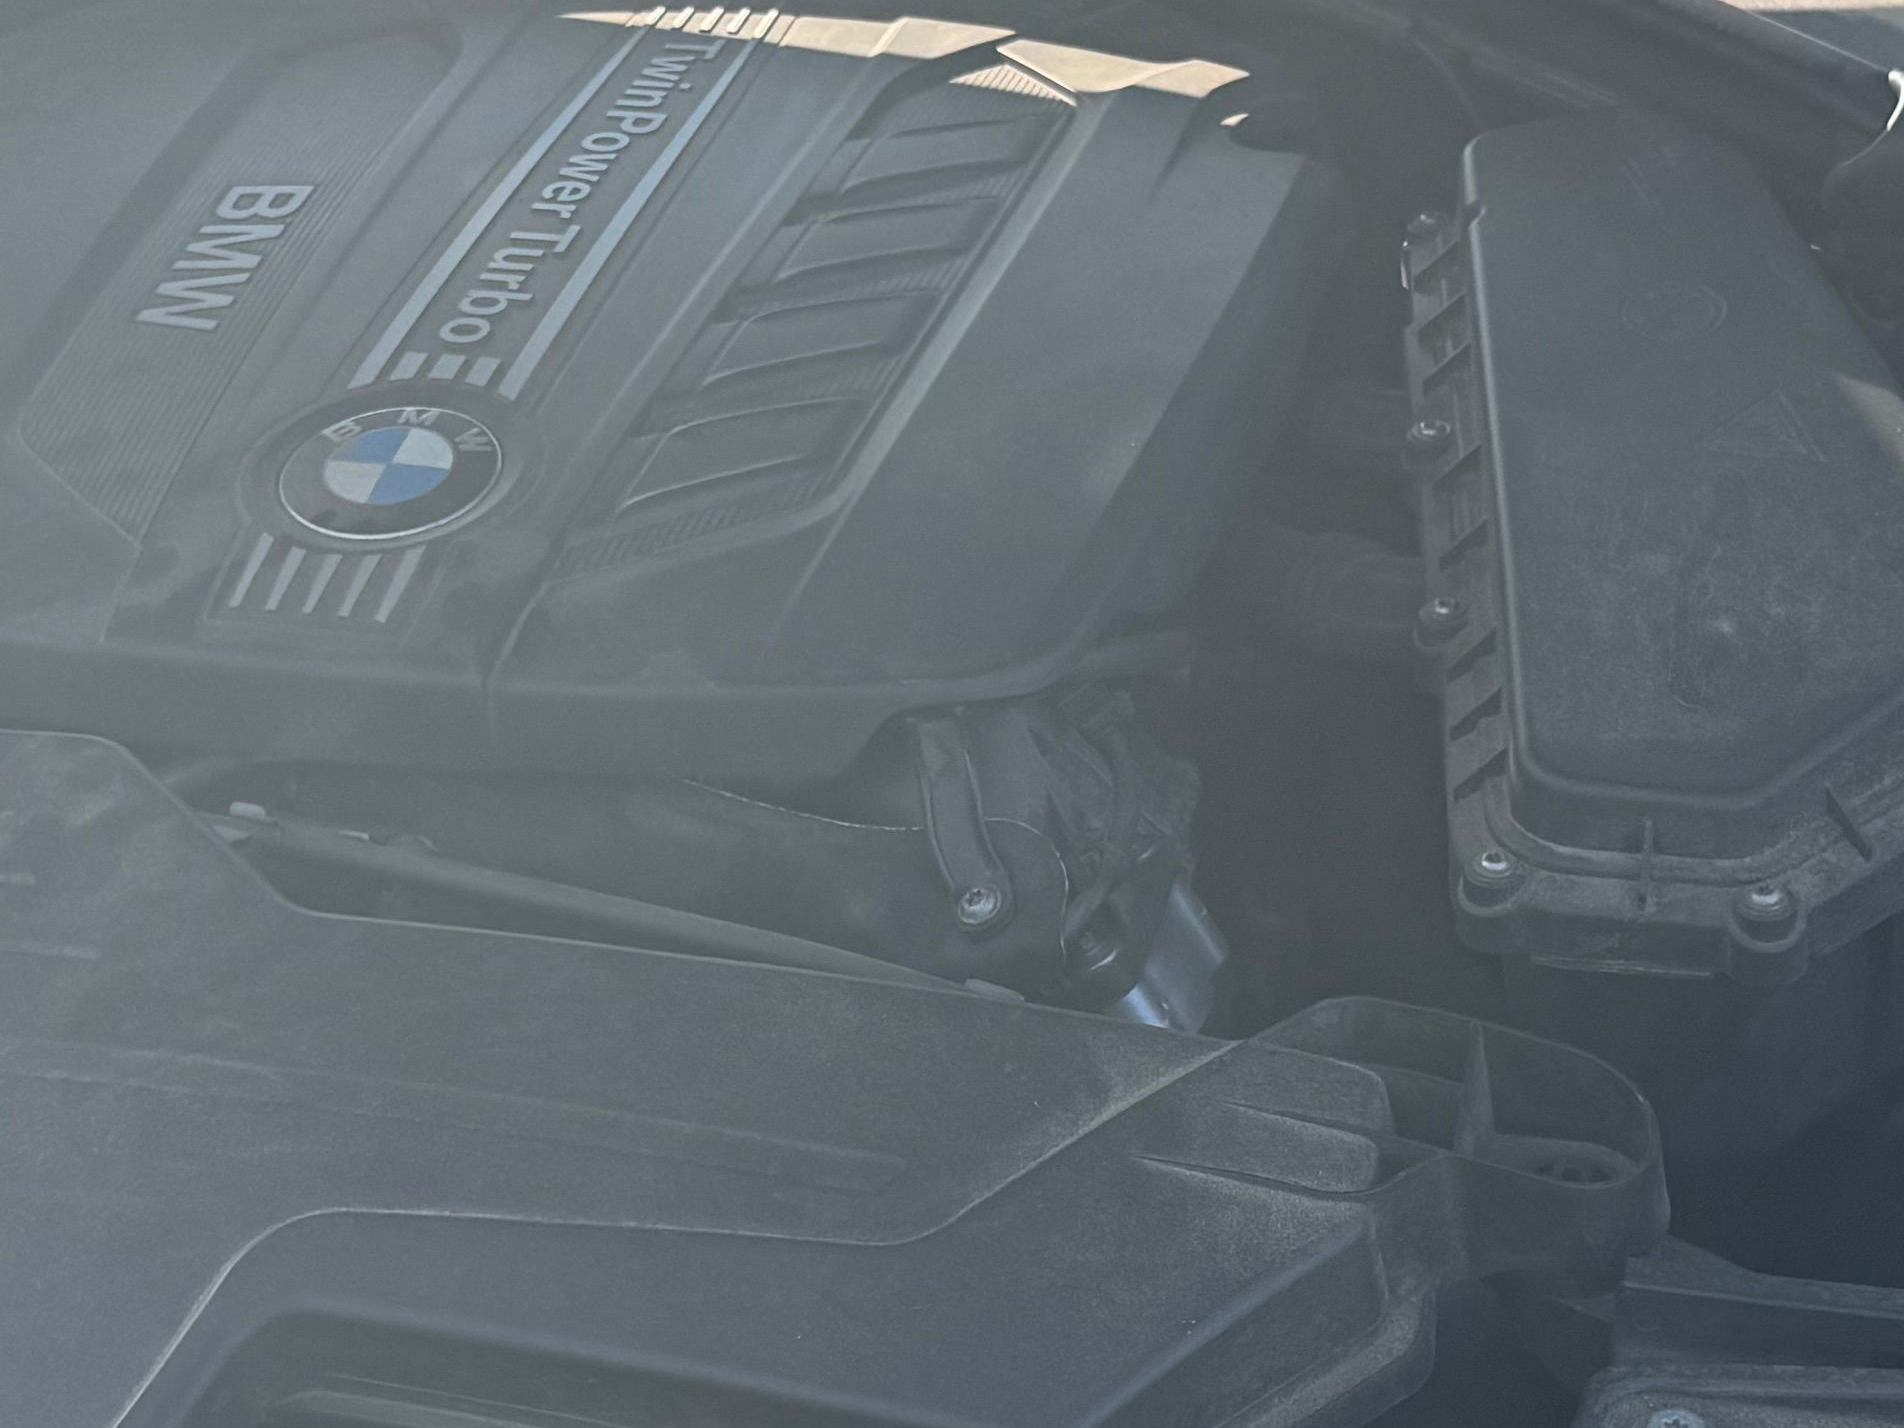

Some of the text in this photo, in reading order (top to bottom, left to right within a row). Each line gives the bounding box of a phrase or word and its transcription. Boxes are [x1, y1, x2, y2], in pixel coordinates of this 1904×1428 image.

[135, 184, 315, 333] BMW
[439, 40, 720, 346] TwinPower Turbo
